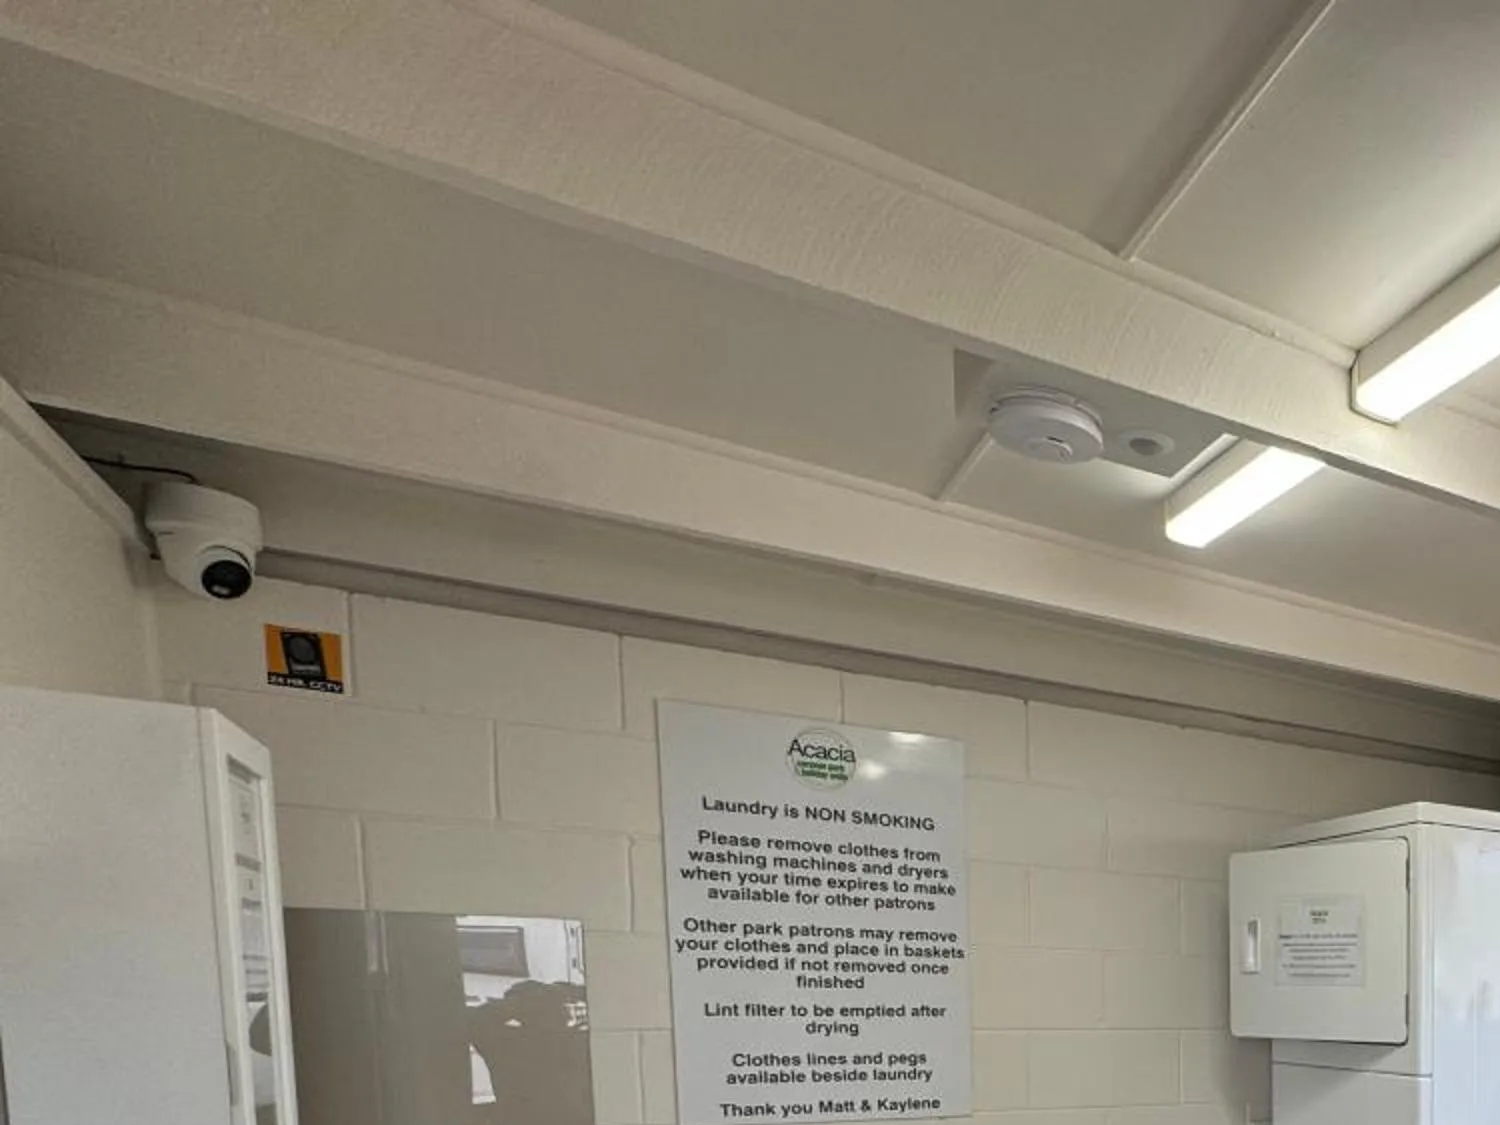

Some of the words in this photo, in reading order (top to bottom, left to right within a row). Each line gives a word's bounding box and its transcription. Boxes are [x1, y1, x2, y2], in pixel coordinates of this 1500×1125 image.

[786, 738, 856, 762] Acacia
[703, 796, 778, 818] Laundry
[784, 804, 800, 818] is
[805, 806, 847, 821] NON
[852, 810, 935, 830] SMOKING
[697, 830, 761, 847] Please
[767, 837, 833, 853] remove
[838, 842, 900, 858] clothes
[903, 847, 941, 861] from
[688, 848, 767, 868] washing
[773, 855, 856, 872] machines
[862, 859, 894, 874] and
[898, 862, 949, 880] dryers
[680, 866, 732, 881] when
[737, 871, 779, 886] your
[784, 873, 822, 886] time
[827, 876, 889, 893] expires
[893, 880, 910, 892] to
[914, 882, 957, 895] make
[707, 886, 791, 902] available
[795, 890, 820, 903] for
[825, 892, 870, 907] other
[874, 896, 936, 910] patrons
[683, 917, 736, 932] Other
[743, 920, 784, 936] park
[789, 924, 855, 939] patrons
[860, 927, 894, 942] may
[898, 930, 958, 941] remove
[676, 937, 718, 952] your
[724, 938, 791, 952] clothes
[796, 941, 830, 953] and
[834, 942, 880, 958] place
[884, 944, 900, 956] in
[904, 945, 965, 958] baskets
[696, 957, 780, 972] provided
[785, 957, 796, 969] if
[800, 959, 830, 971] not
[834, 959, 907, 972] removed
[911, 962, 950, 973] once
[796, 975, 865, 988] finished
[704, 1003, 739, 1016] Lint
[744, 1003, 786, 1016] filter
[790, 1004, 808, 1016] to
[813, 1003, 835, 1016] be
[839, 1003, 906, 1019] emptied
[910, 1003, 948, 1016] after
[805, 1021, 860, 1036] drying
[732, 1052, 801, 1066] Clothes
[807, 1052, 848, 1065] lines
[853, 1052, 884, 1065] and
[888, 1052, 927, 1067] pegs
[726, 1069, 807, 1083] available
[811, 1068, 868, 1081] beside
[872, 1067, 933, 1083] laundry
[721, 1102, 777, 1116] Thank
[781, 1103, 813, 1117] you
[819, 1100, 856, 1113] Matt
[860, 1099, 873, 1111] &
[877, 1096, 942, 1113] Kaylene
